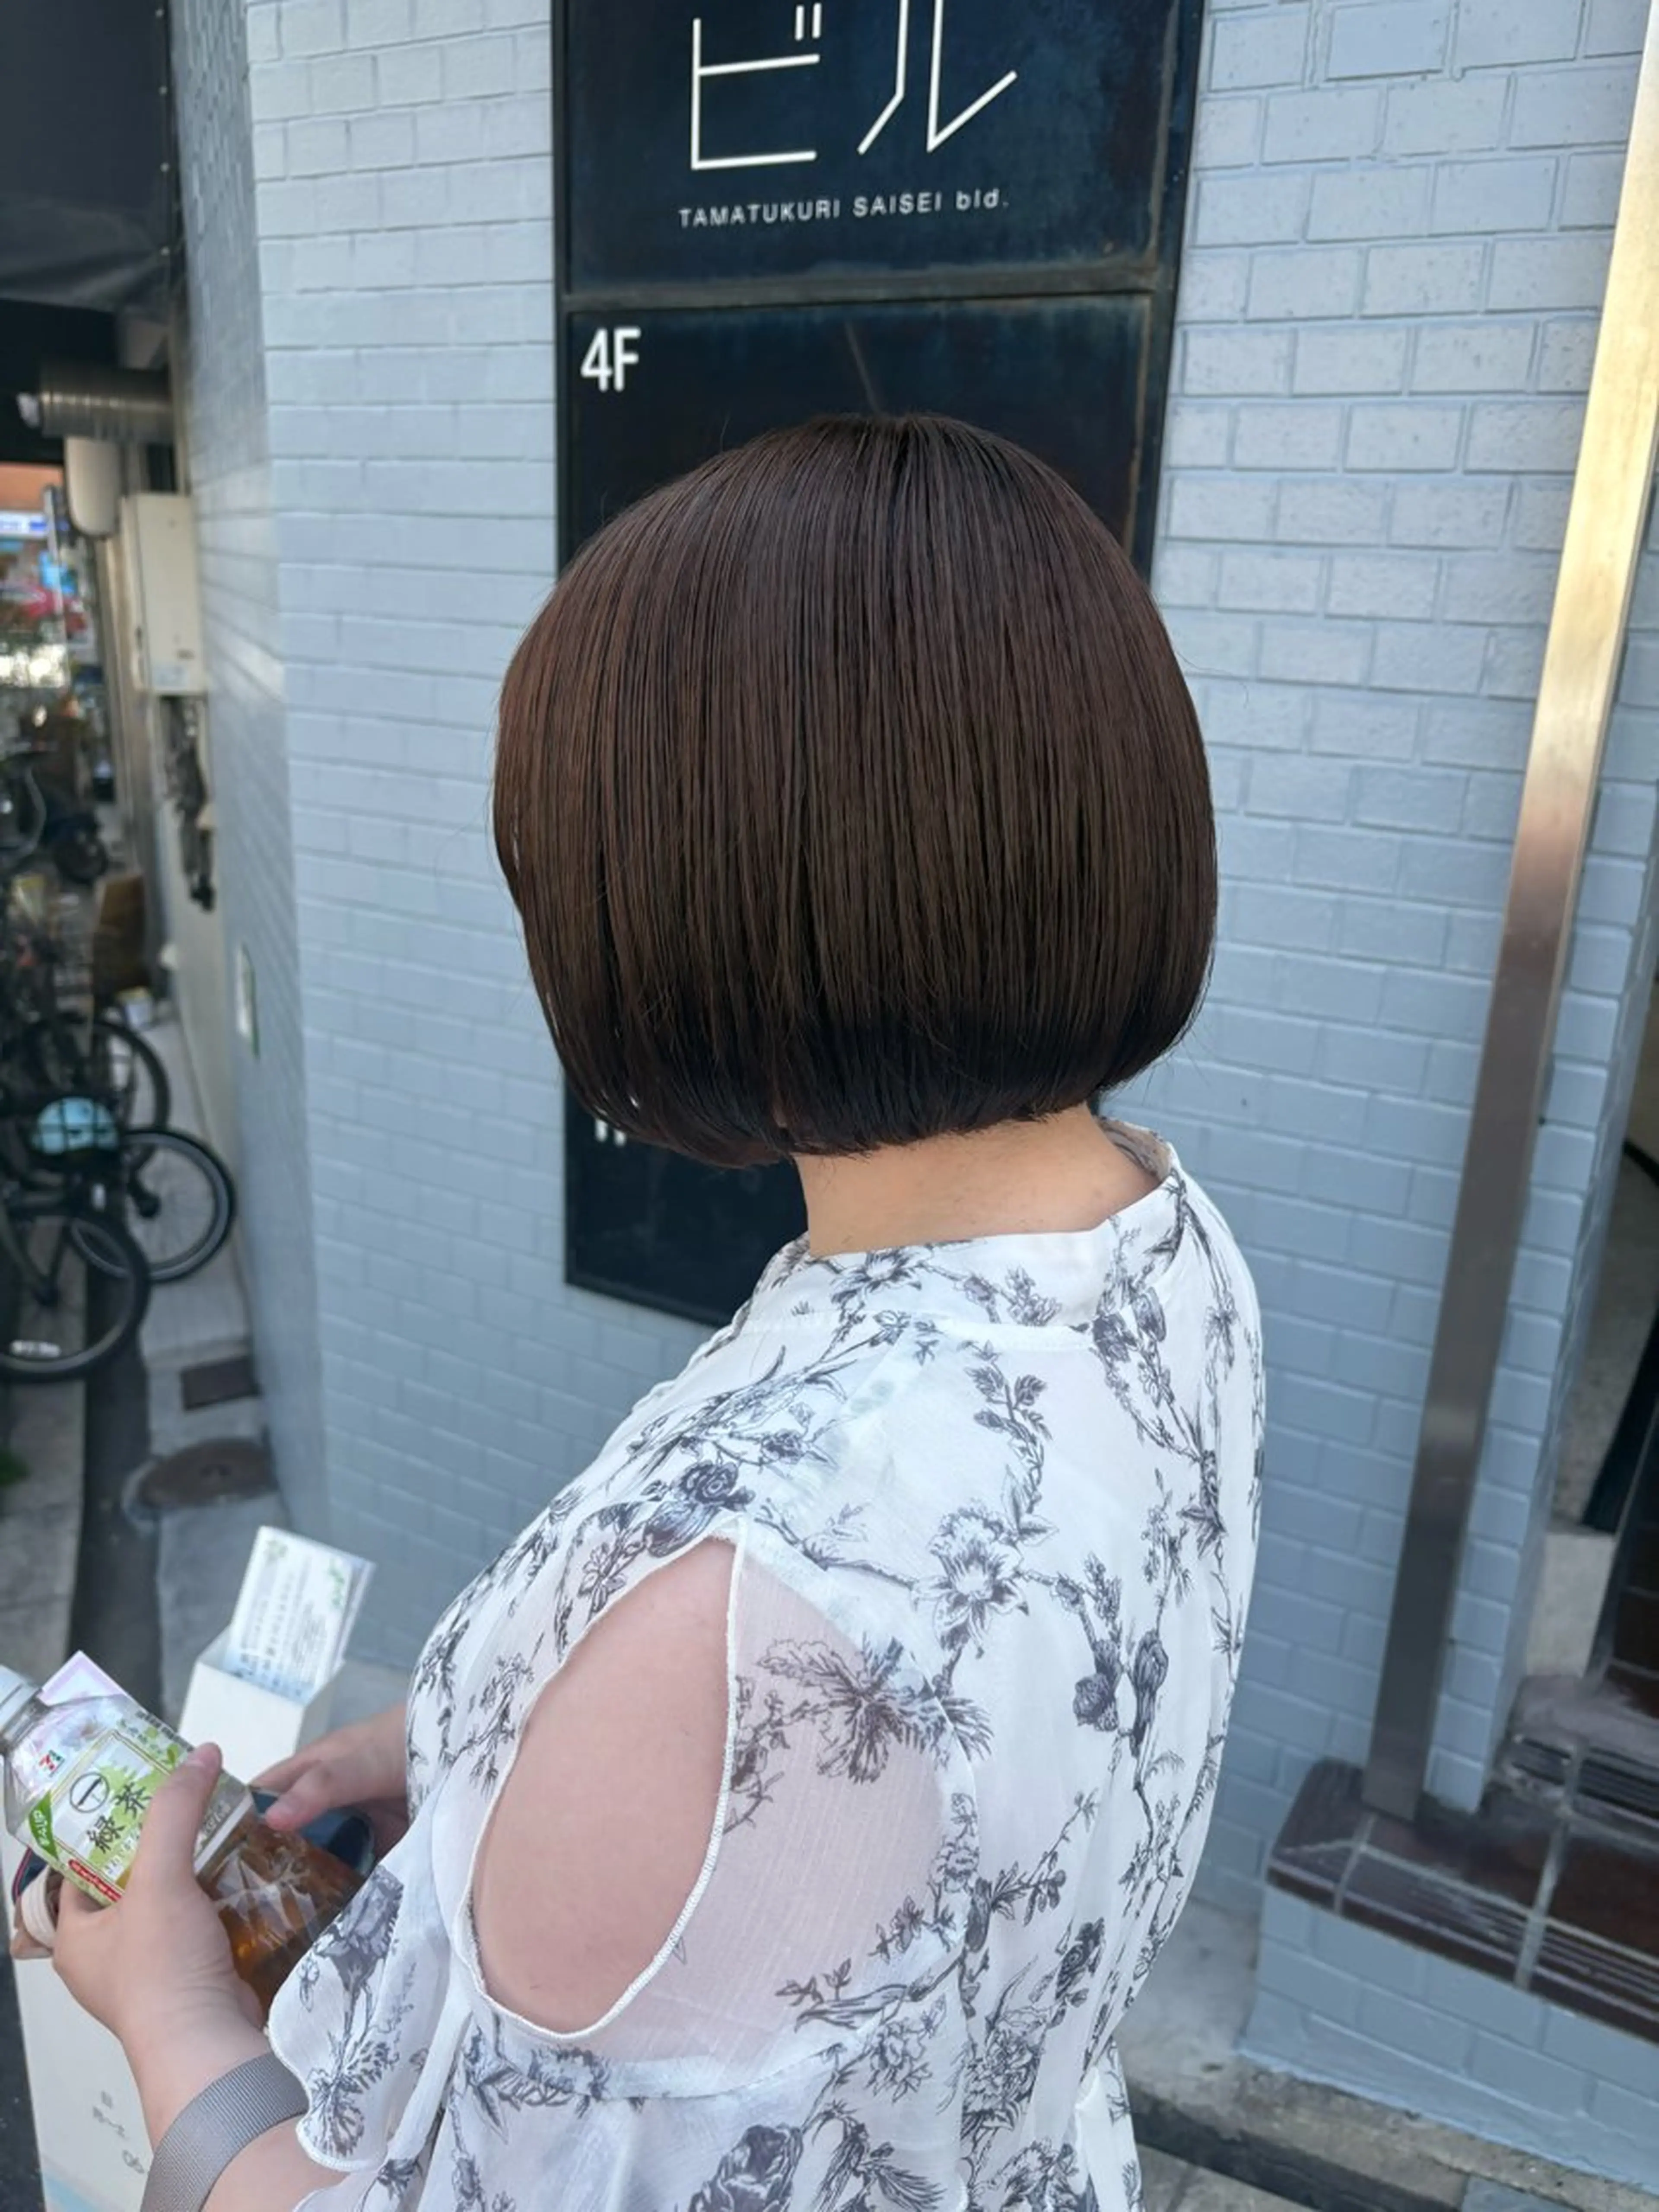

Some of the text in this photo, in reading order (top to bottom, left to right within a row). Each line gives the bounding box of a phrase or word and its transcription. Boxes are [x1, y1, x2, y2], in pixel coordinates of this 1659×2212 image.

[691, 0, 1017, 170] ビル
[678, 188, 1009, 227] TAMATUKURI SAISEI bld.
[580, 327, 642, 391] 4F
[86, 1781, 153, 1853] 緑茶
